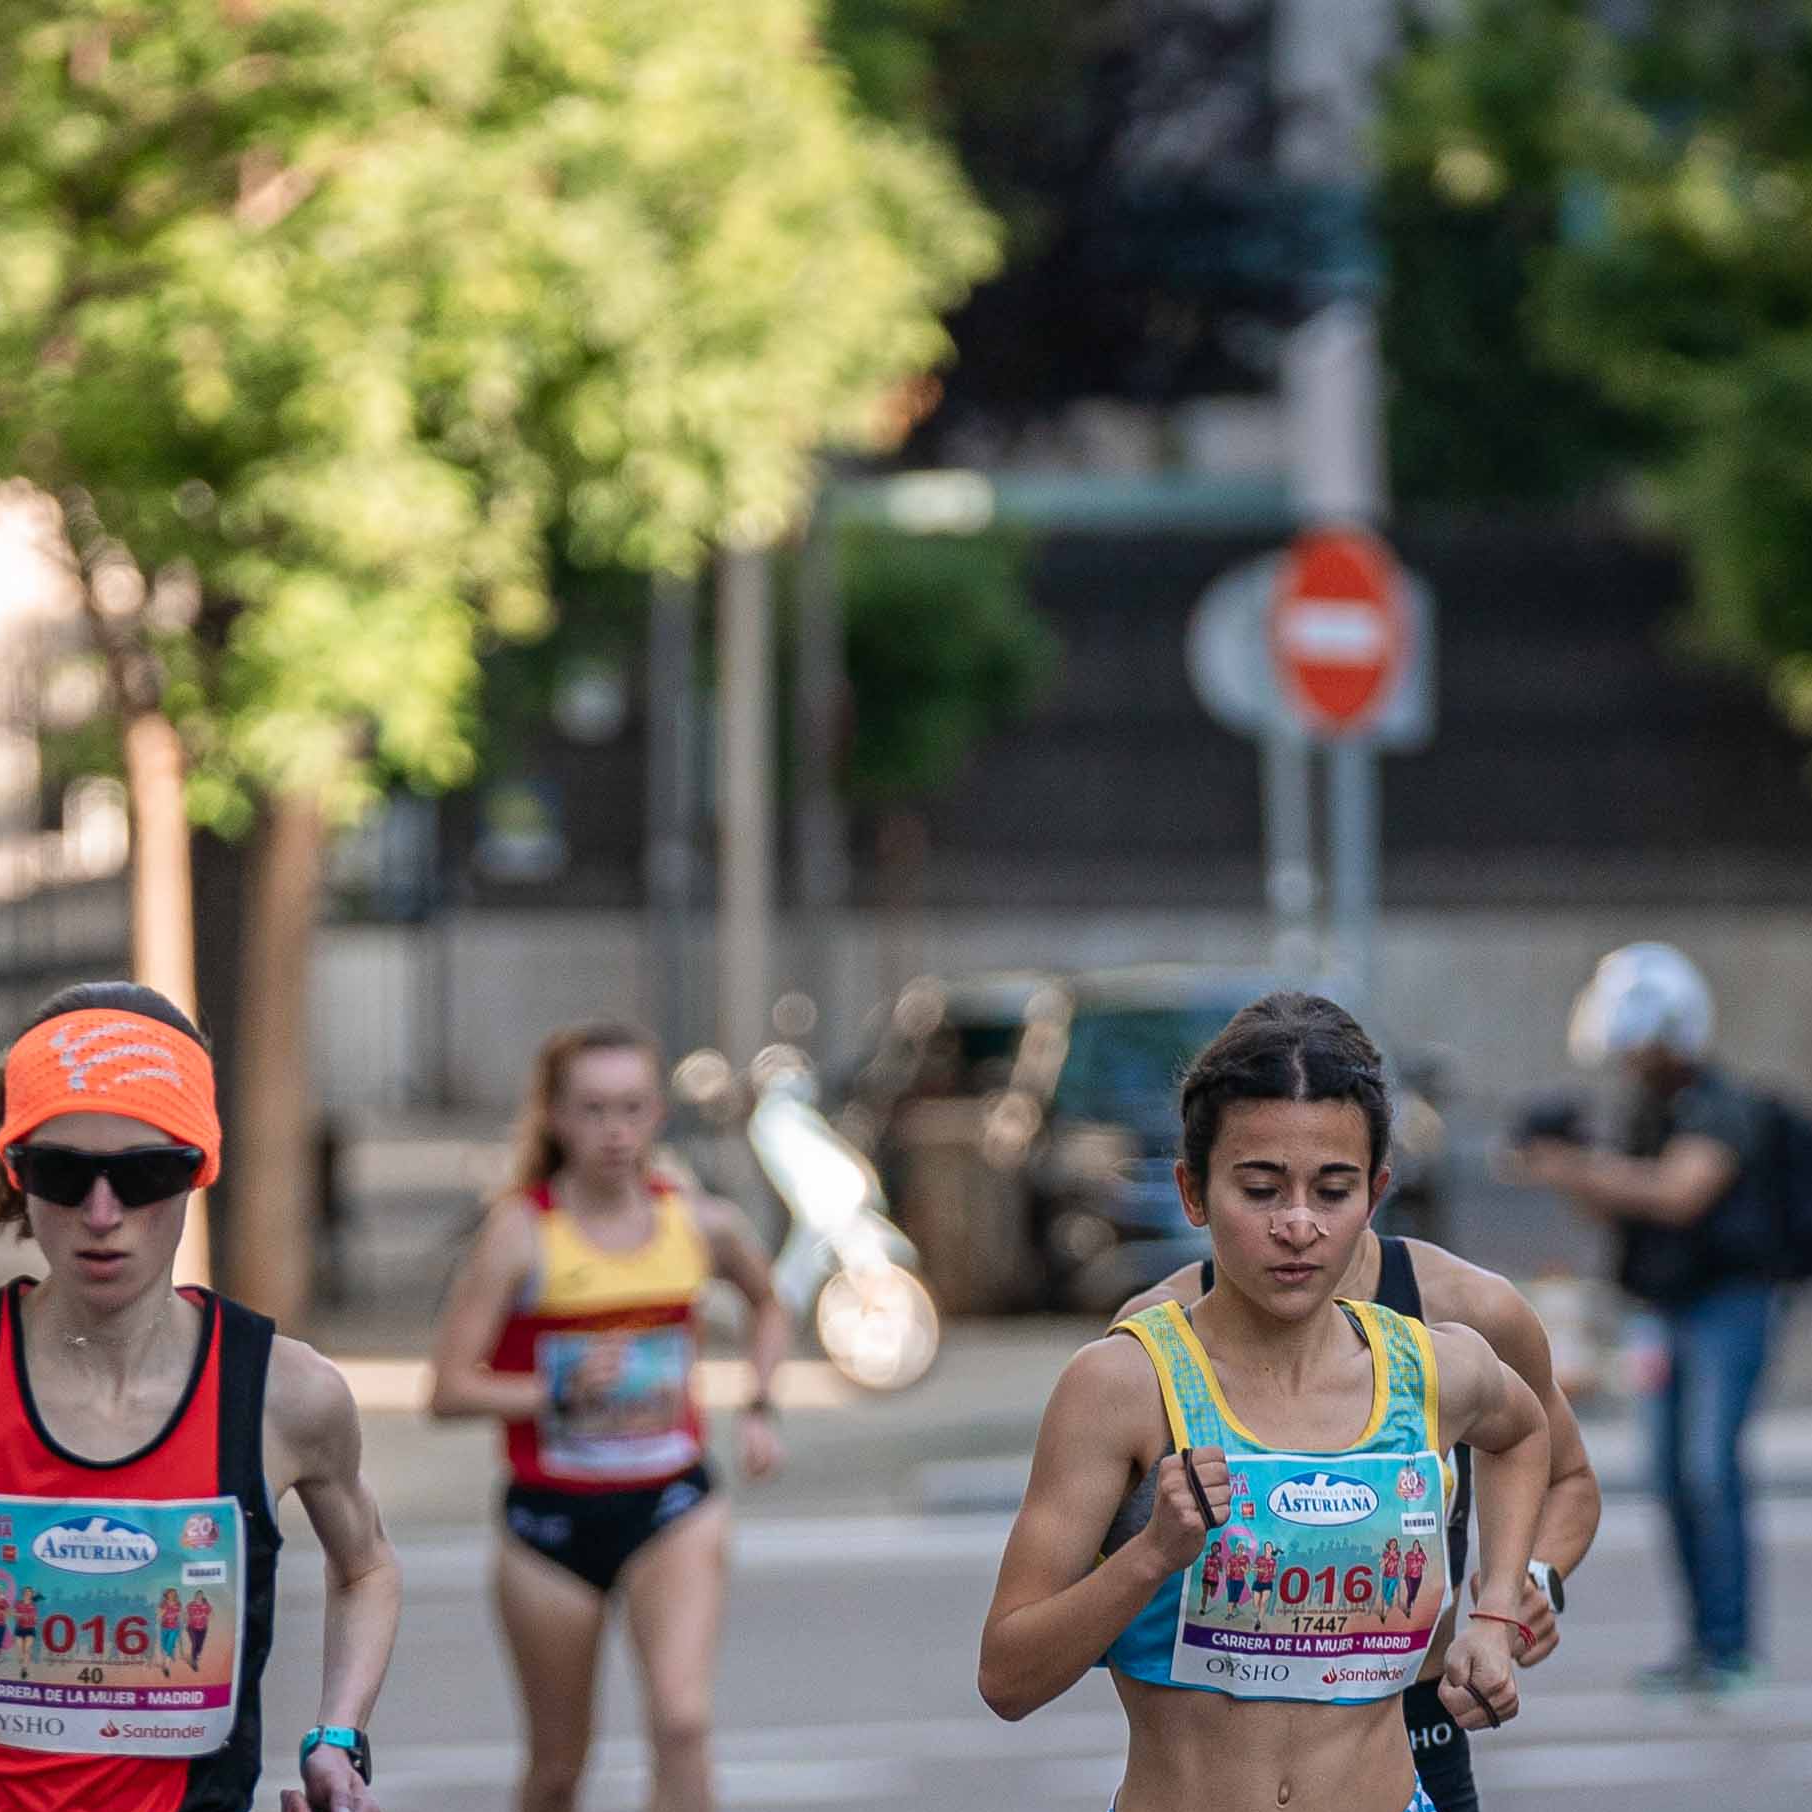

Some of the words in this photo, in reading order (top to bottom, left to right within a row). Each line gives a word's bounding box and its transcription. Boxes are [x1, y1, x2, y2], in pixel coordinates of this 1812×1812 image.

[1276, 1489, 1372, 1512] ASTURIANA
[41, 1535, 150, 1561] ASTURIANA
[1279, 1565, 1374, 1605] 016
[42, 1614, 150, 1655] 016
[1291, 1616, 1348, 1633] 17447
[1212, 1632, 1271, 1650] CARRERA
[1275, 1635, 1292, 1651] DE
[1296, 1637, 1311, 1652] LA
[1315, 1637, 1353, 1653] MUJER
[1363, 1635, 1411, 1650] MADRID
[77, 1667, 104, 1684] 40
[1206, 1657, 1290, 1682] OYSHO
[1339, 1666, 1407, 1684] Santander
[44, 1688, 63, 1703] DE
[66, 1688, 84, 1704] LA
[88, 1690, 136, 1706] MUJER
[148, 1690, 204, 1706] MADRID
[123, 1723, 207, 1739] Santander
